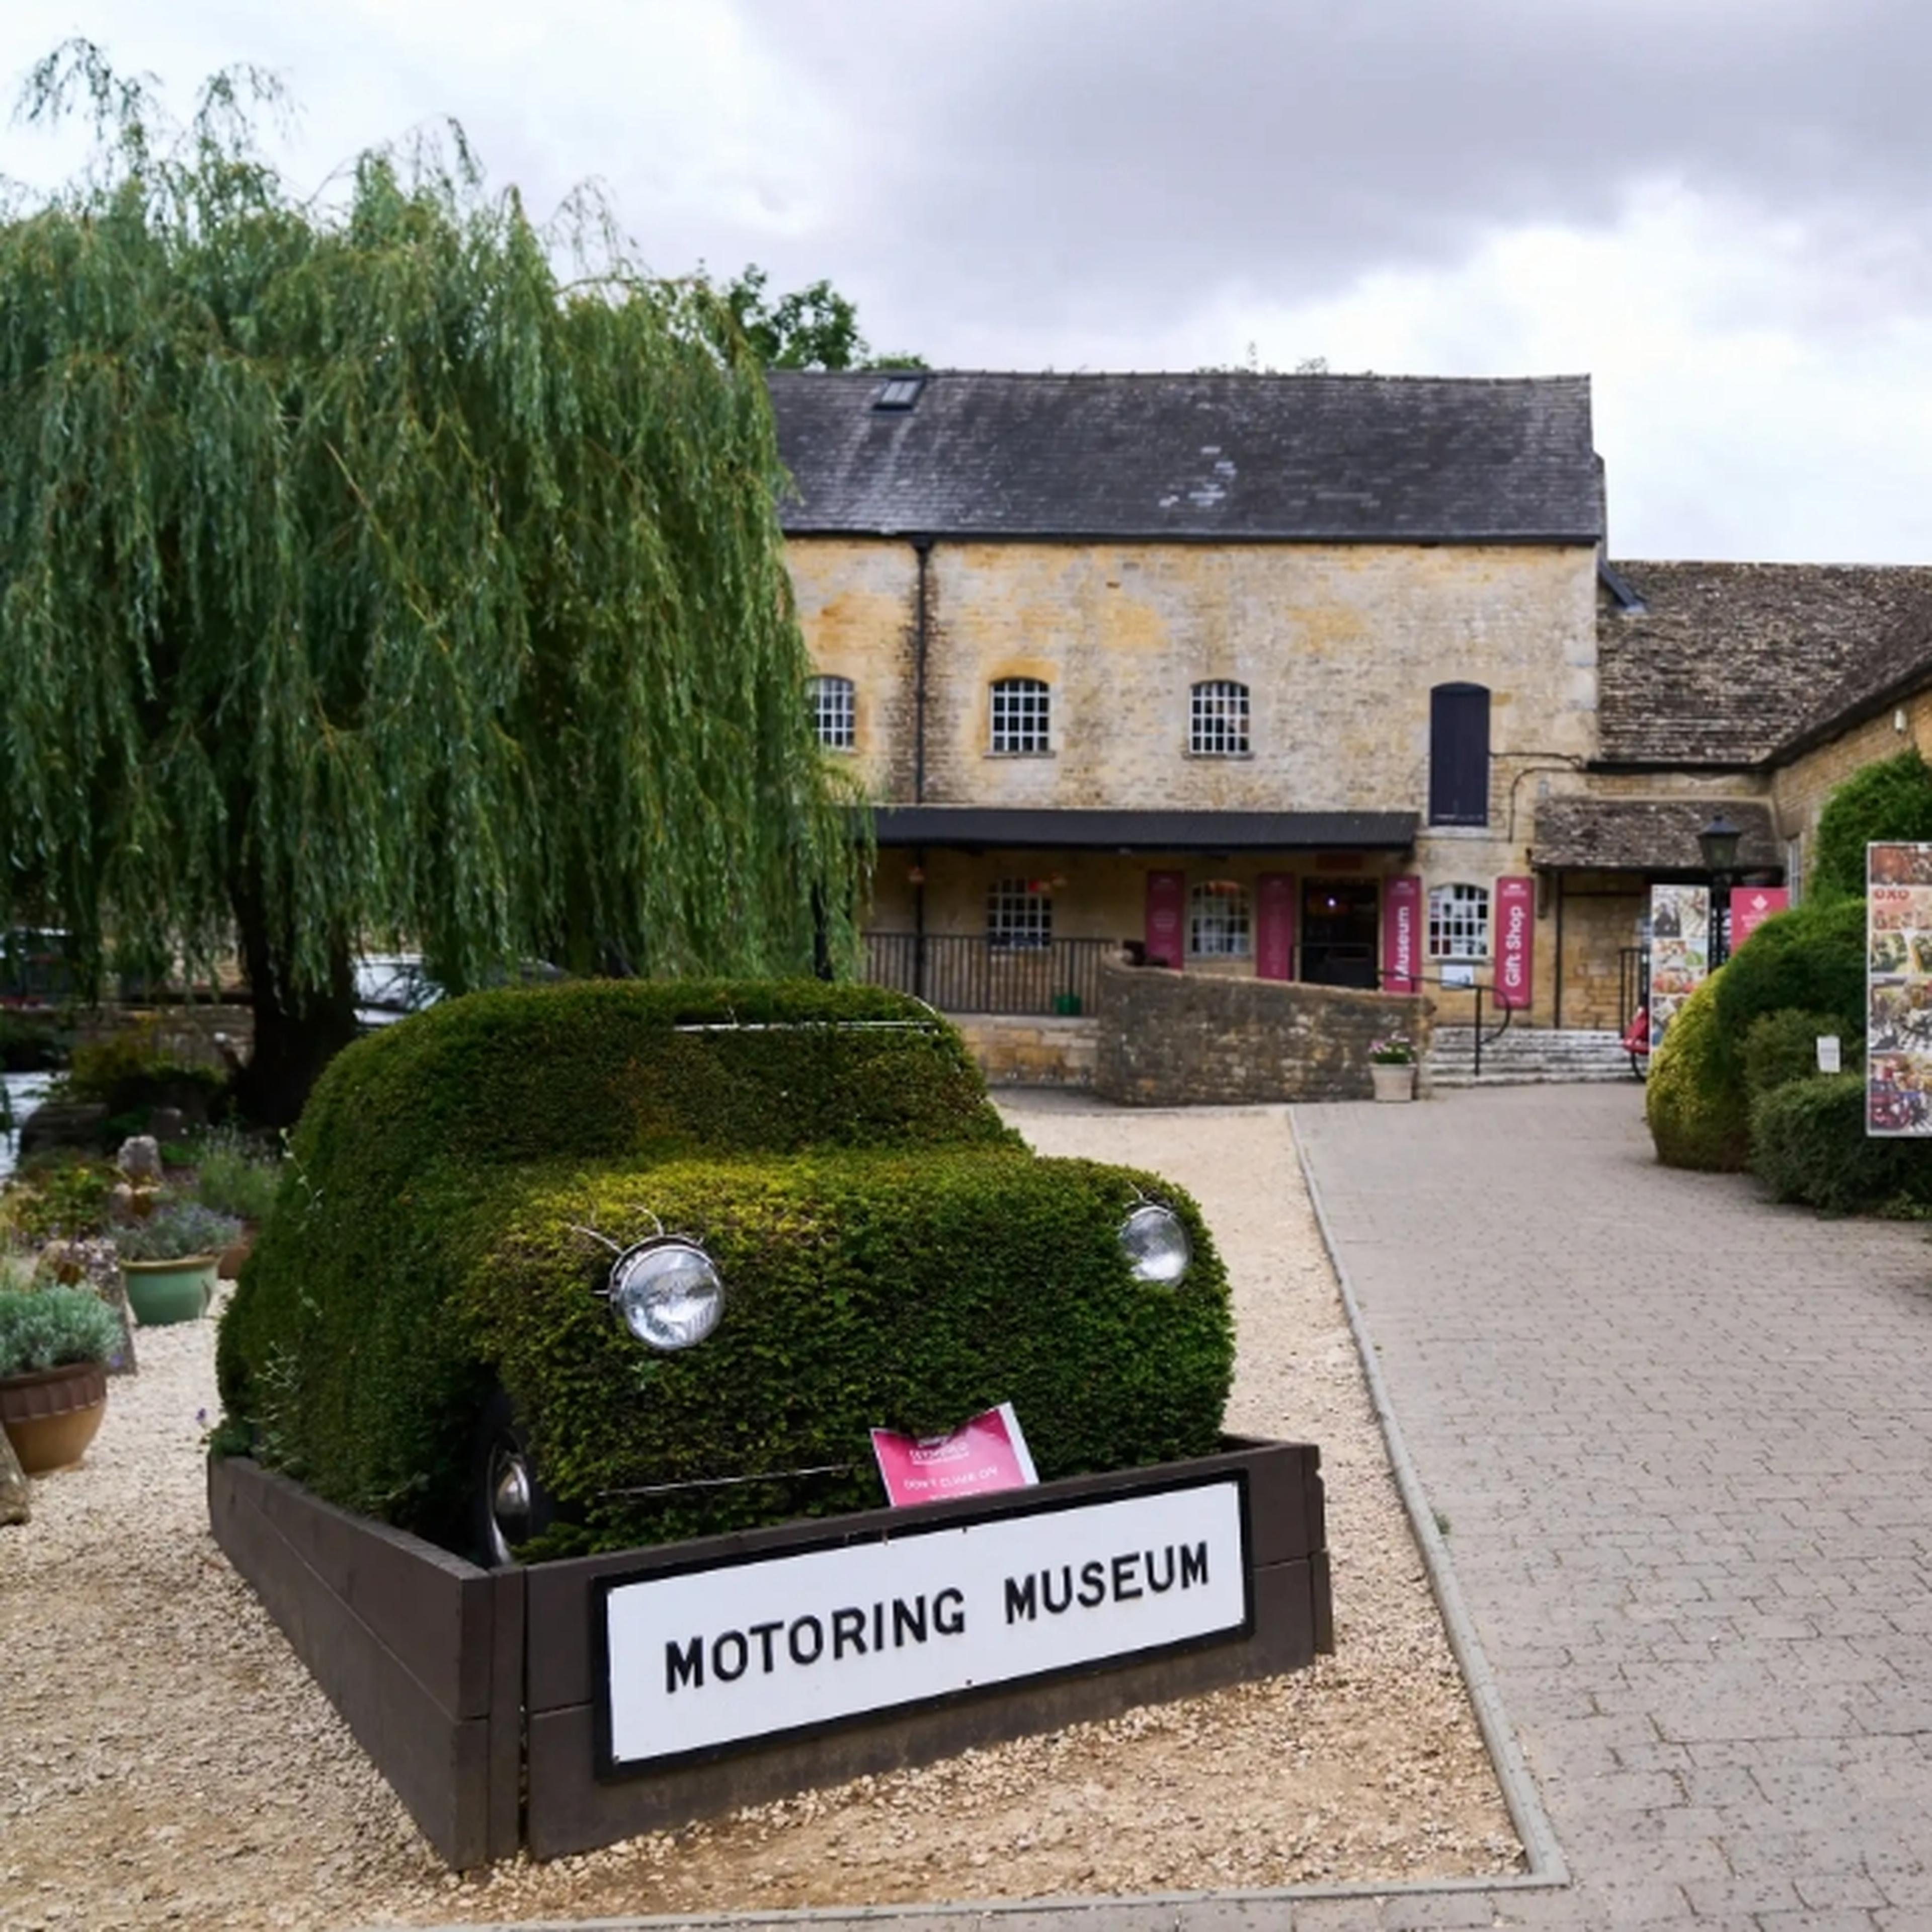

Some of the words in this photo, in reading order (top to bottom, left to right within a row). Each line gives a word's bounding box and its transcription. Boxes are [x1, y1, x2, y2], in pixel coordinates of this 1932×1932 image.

[1394, 906, 1410, 981] Museum
[1506, 906, 1525, 949] Shop
[1505, 954, 1521, 987] Gift
[665, 1587, 965, 1694] MOTORING
[1004, 1541, 1209, 1625] MUSEUM
